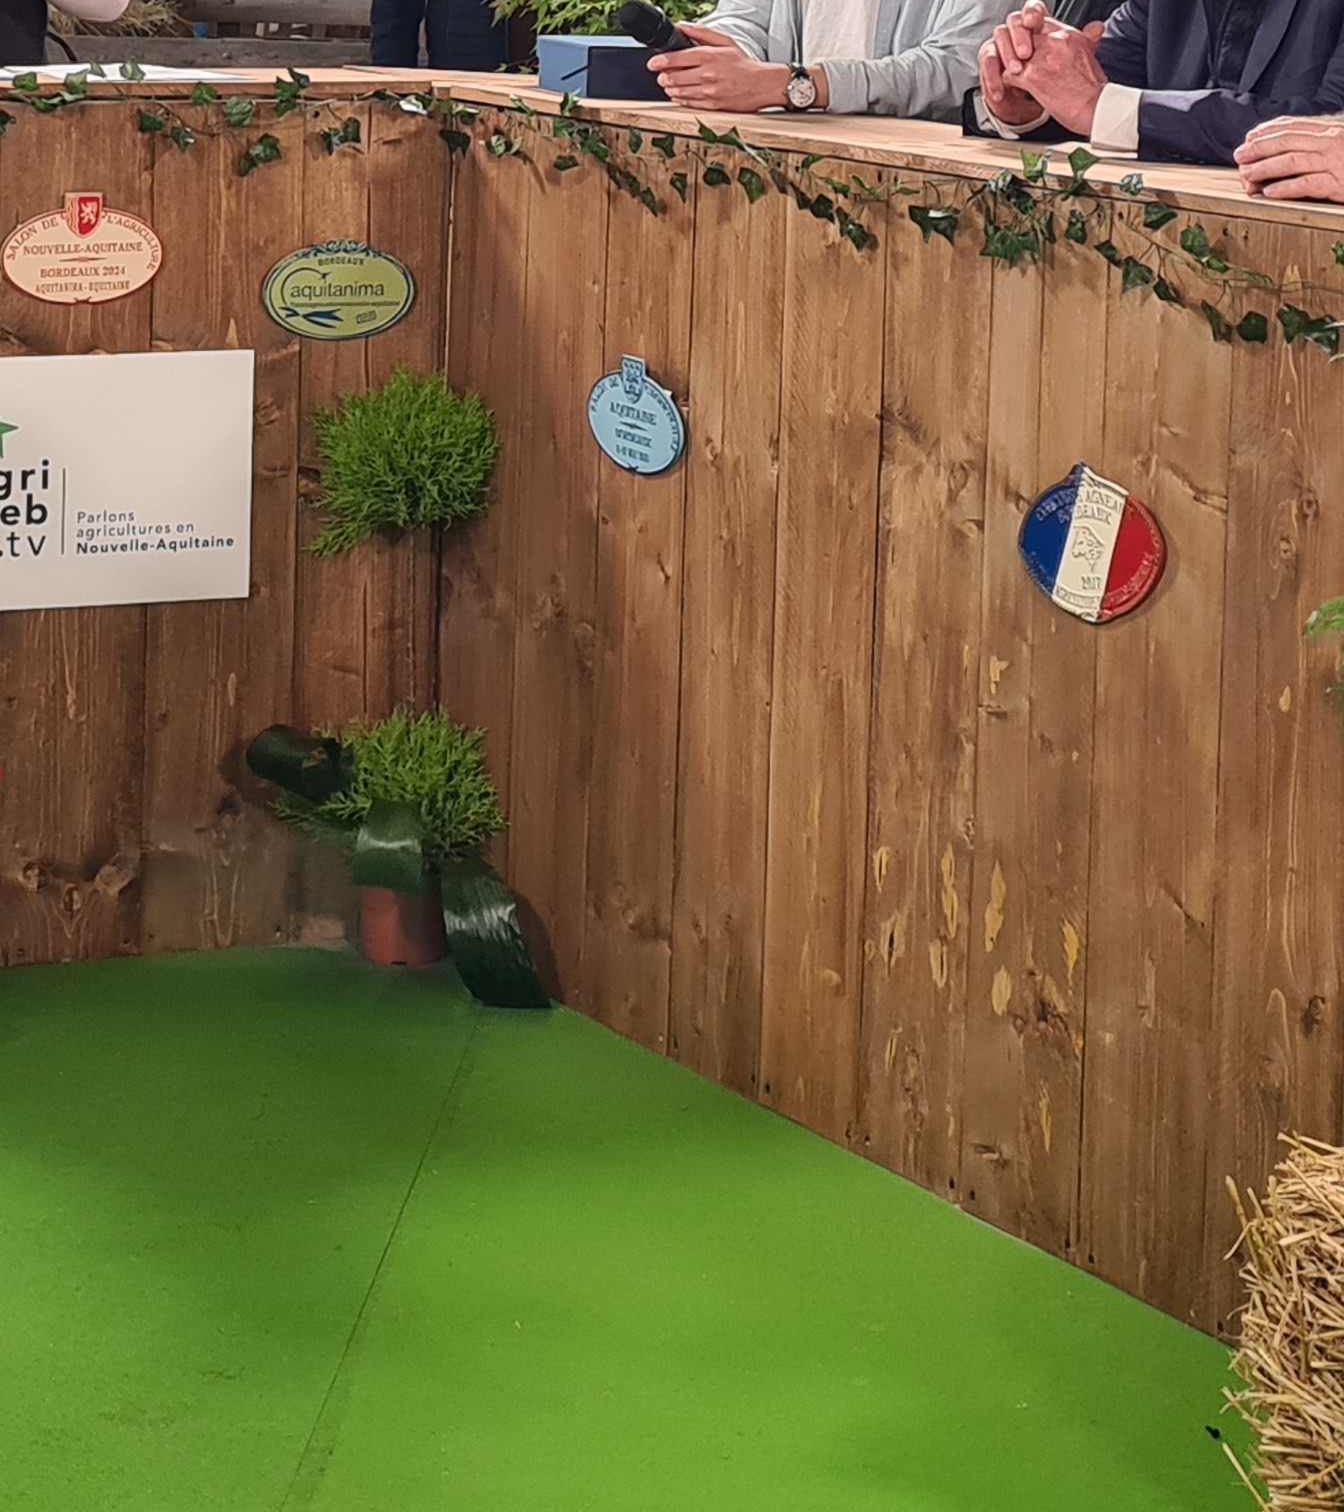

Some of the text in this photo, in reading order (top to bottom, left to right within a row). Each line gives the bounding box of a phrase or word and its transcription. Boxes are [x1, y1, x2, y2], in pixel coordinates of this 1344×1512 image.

[6, 215, 160, 271] SALON DE L'AGRICULTURE
[23, 241, 144, 256] NOUVELLE-AQUITAINE
[318, 257, 364, 267] BORDEAUX
[40, 266, 100, 278] BORDEAUX
[290, 281, 385, 300] aquitanima
[77, 510, 136, 524] Parlons
[76, 523, 195, 540] agricultures en
[76, 536, 235, 555] Nouvelle-Aquitaine
